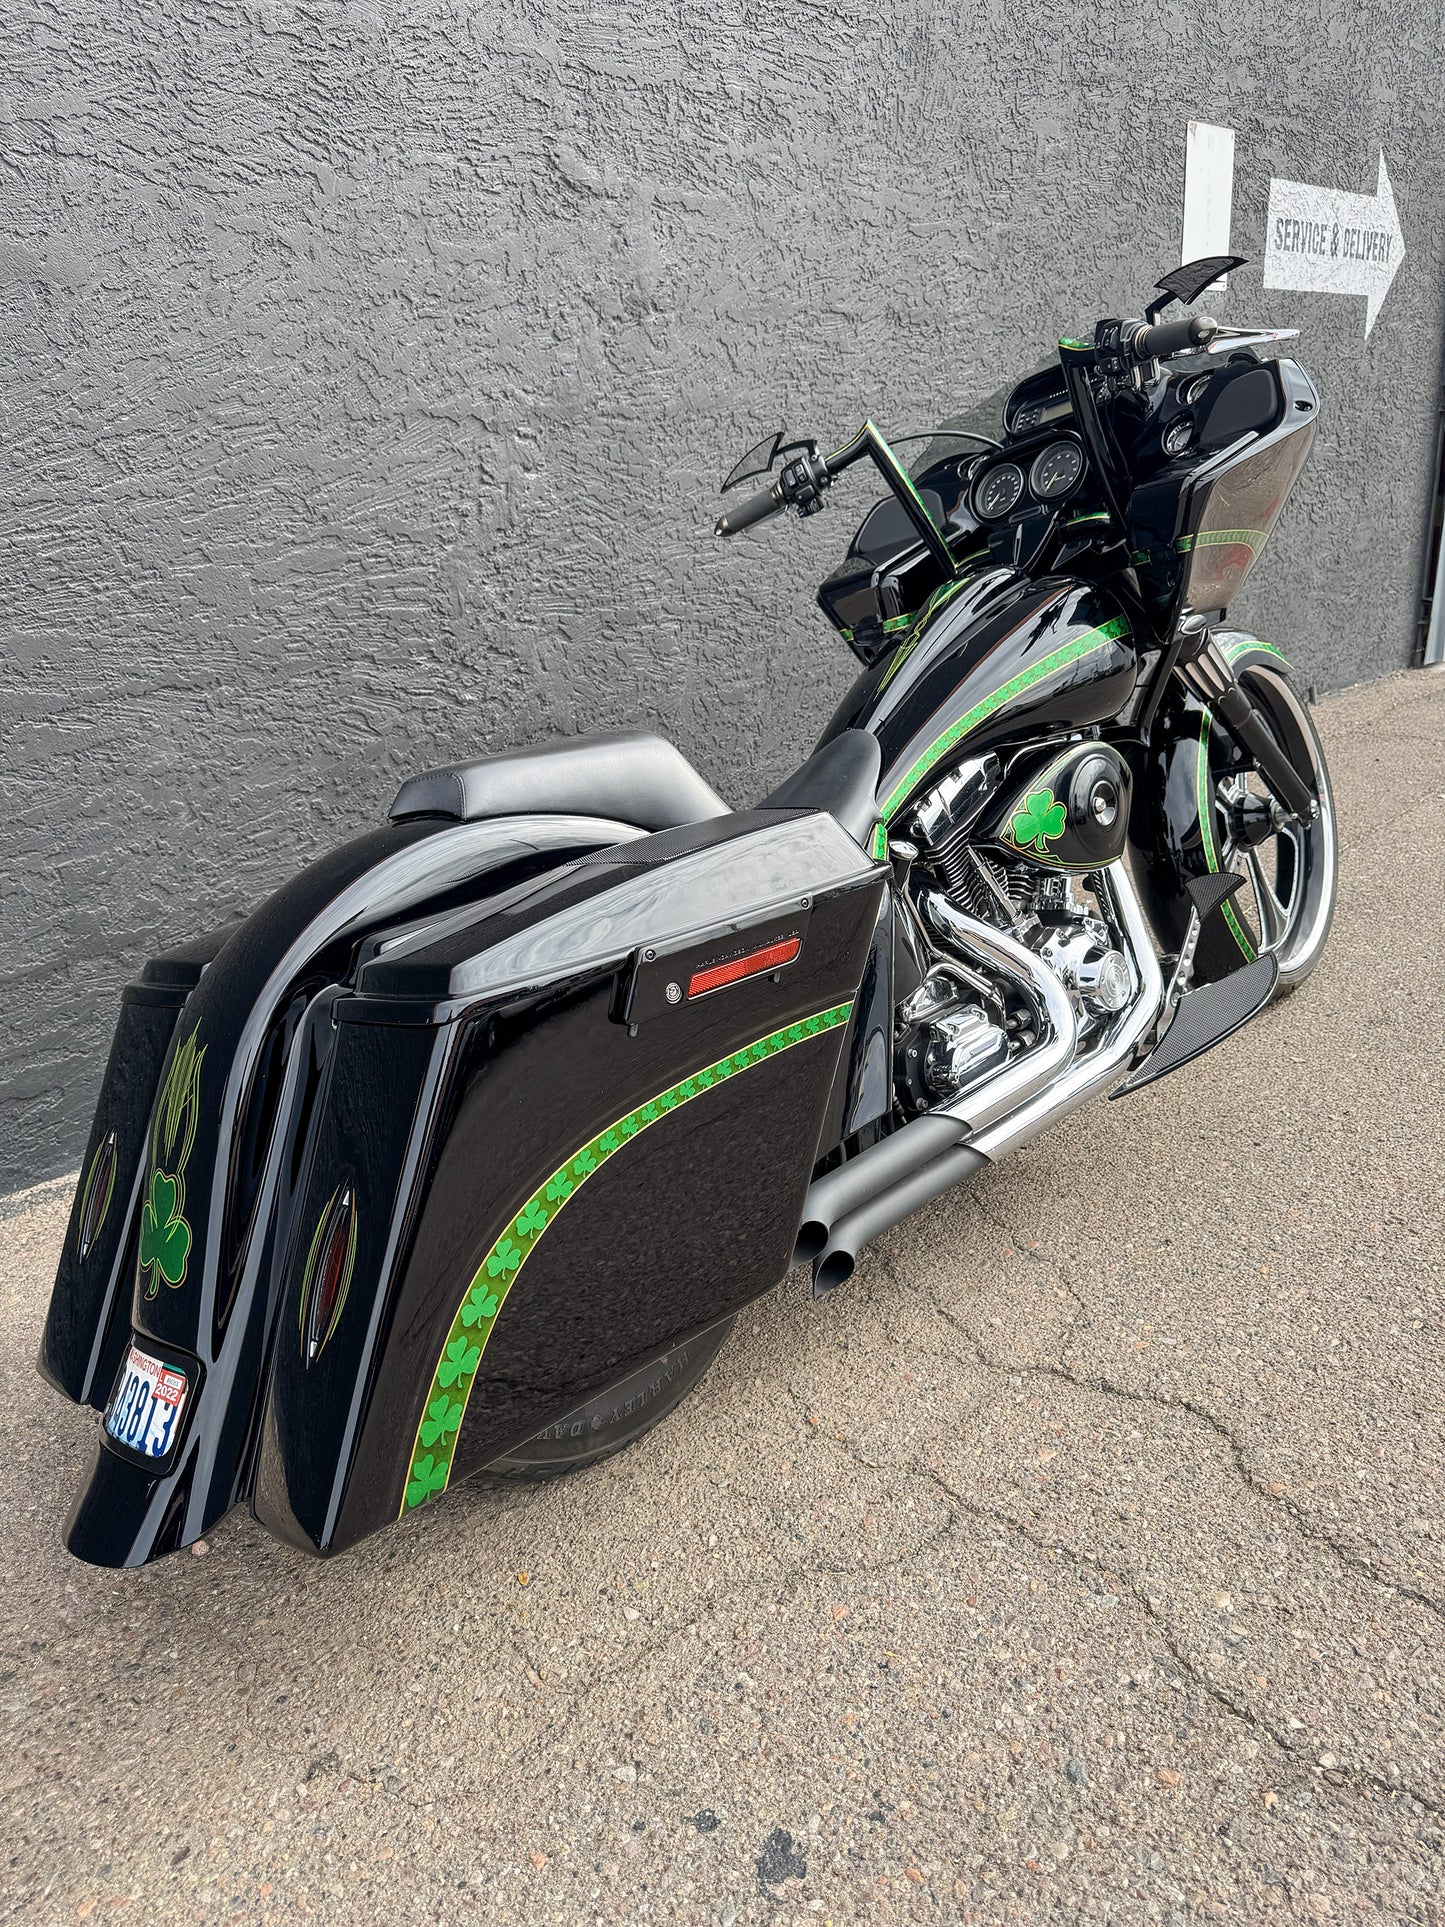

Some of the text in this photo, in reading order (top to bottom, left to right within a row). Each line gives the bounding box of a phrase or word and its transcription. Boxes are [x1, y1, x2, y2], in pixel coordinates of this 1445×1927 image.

[1274, 217, 1393, 262] SERVICE & DELIVERY
[155, 1383, 179, 1402] 2022
[609, 1351, 691, 1424] HARLEY
